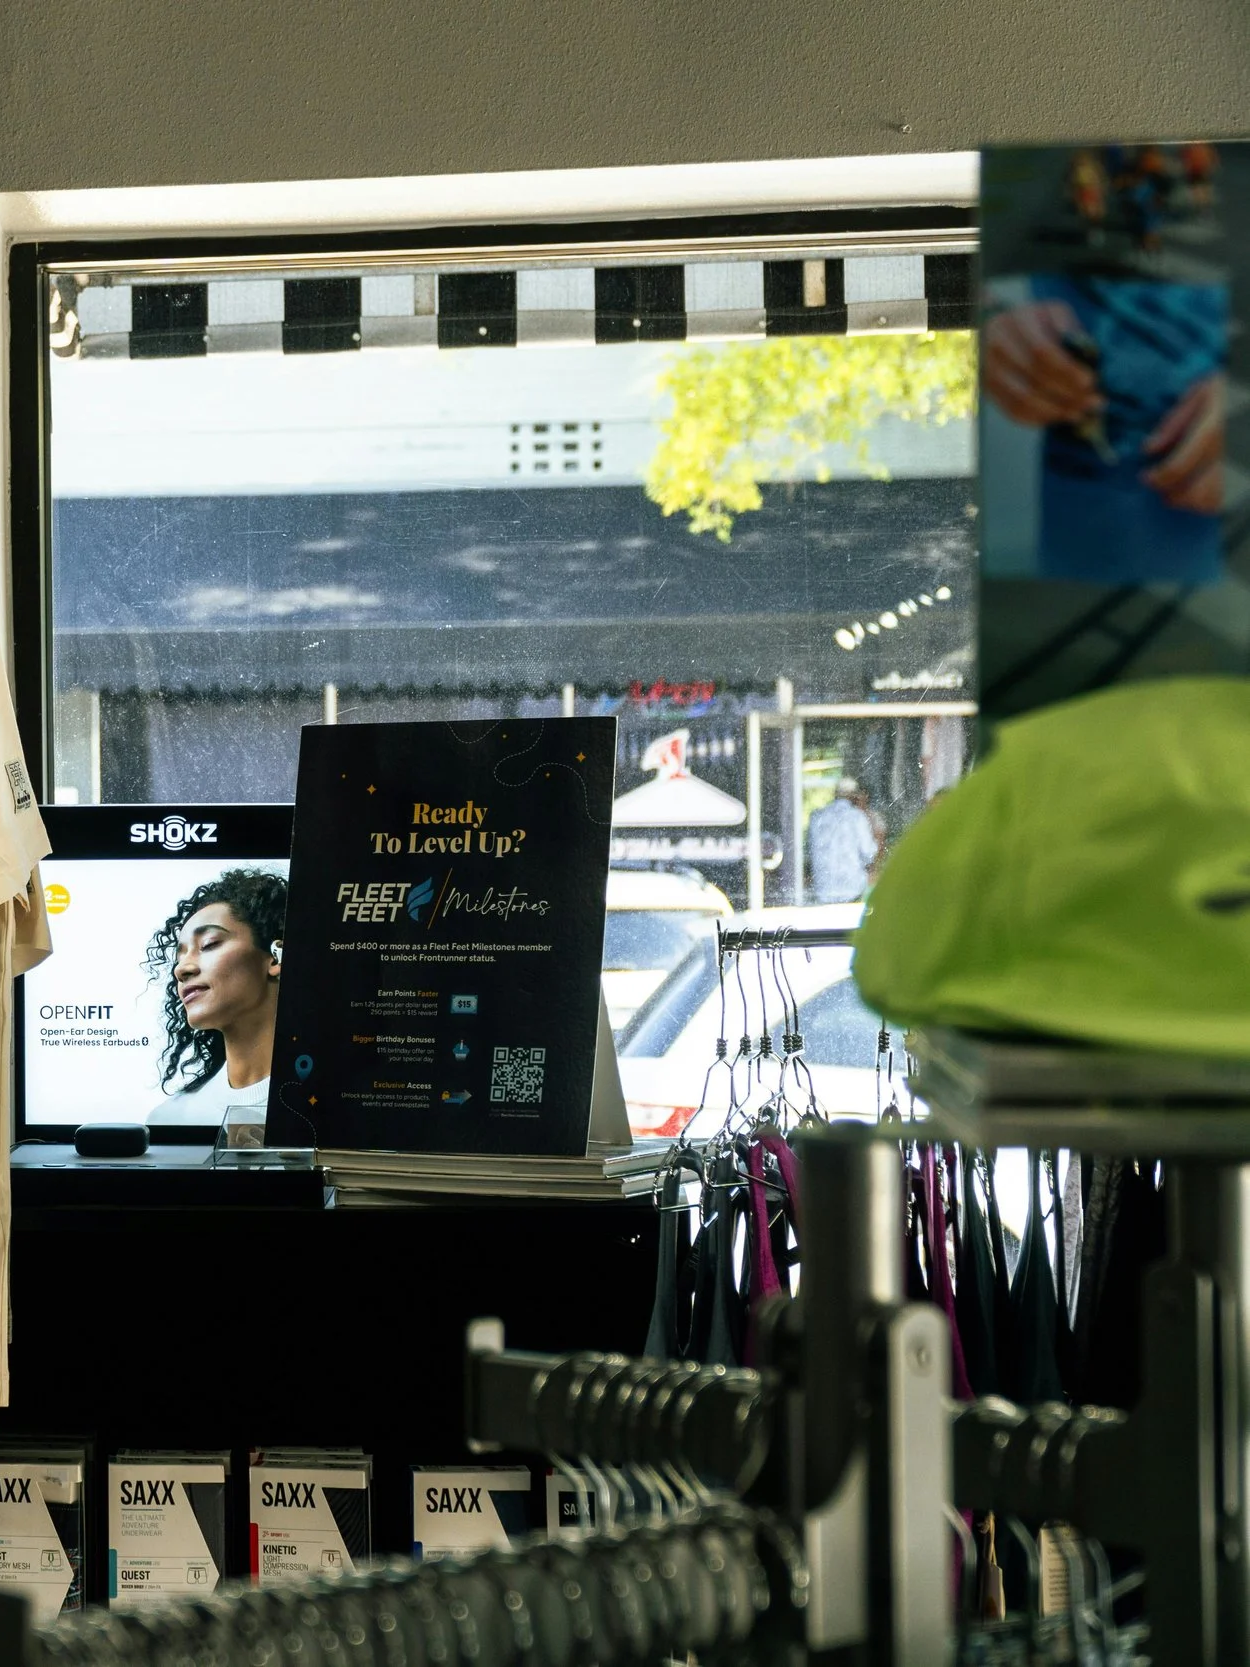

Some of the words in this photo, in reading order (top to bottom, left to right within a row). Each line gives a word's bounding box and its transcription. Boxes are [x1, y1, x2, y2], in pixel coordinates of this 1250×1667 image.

[411, 800, 488, 829] Ready
[130, 821, 218, 845] SHOKZ
[370, 832, 401, 854] To
[407, 830, 471, 854] Level
[478, 829, 526, 858] Up?
[337, 883, 411, 902] FLEET
[442, 886, 551, 921] Milestones
[342, 903, 403, 922] FEET
[330, 942, 355, 951] Spend
[356, 942, 378, 950] $400
[429, 942, 450, 950] Fleet
[451, 943, 469, 951] Feet
[471, 943, 515, 951] Milestones
[380, 953, 389, 961] to
[391, 953, 417, 961] unlock
[419, 954, 467, 962] Frontrunner
[469, 954, 496, 962] status.
[377, 989, 393, 997] Earn
[417, 990, 439, 998] Faster
[457, 1000, 471, 1009] $15
[40, 1005, 113, 1020] OPENFIT
[40, 1027, 84, 1038] Open-Ear
[87, 1027, 118, 1039] Design
[41, 1038, 60, 1047] True
[62, 1038, 100, 1047] Wireless
[103, 1038, 140, 1047] Earbuds
[352, 1035, 375, 1044] Bigger
[376, 1035, 406, 1044] Birthday
[120, 1480, 175, 1506] SAXX
[261, 1481, 316, 1509] SAXX
[426, 1487, 482, 1513] SAXX
[263, 1544, 297, 1555] KINETIC
[12, 1562, 31, 1570] MESH
[263, 1562, 309, 1571] COMPRESSION
[121, 1570, 150, 1581] QUEST
[263, 1569, 282, 1577] MESH
